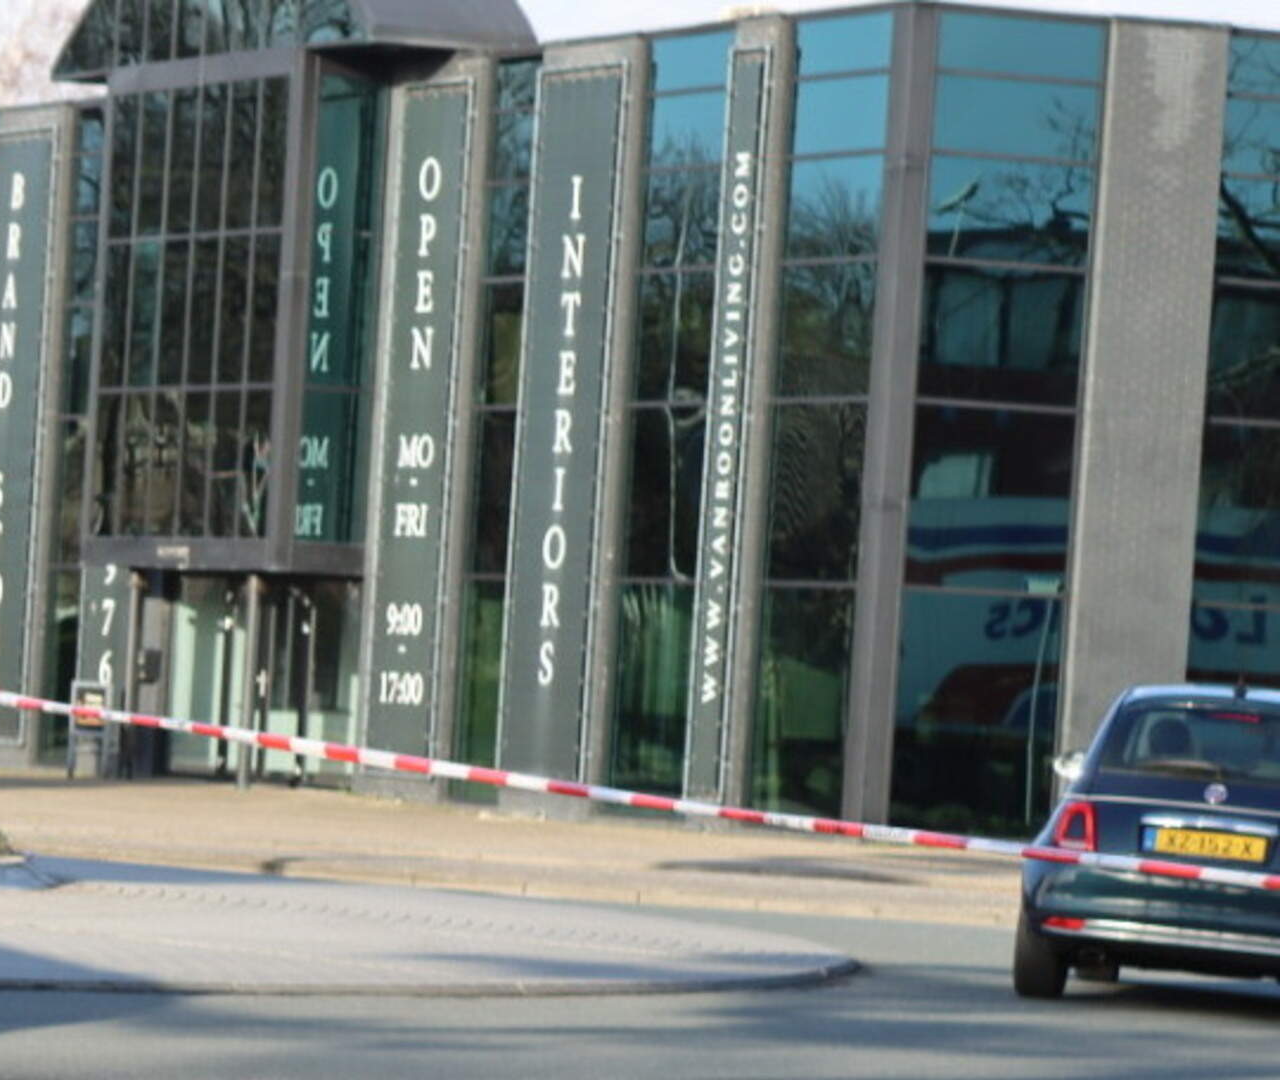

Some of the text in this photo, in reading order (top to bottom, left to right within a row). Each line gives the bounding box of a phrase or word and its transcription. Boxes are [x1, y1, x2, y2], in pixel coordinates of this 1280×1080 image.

[409, 156, 442, 370] OPEN
[538, 175, 585, 686] INTERIORS
[701, 151, 751, 704] WWW.VANROONLIVING.COM
[397, 434, 434, 468] MO
[394, 503, 428, 537] FRI
[386, 603, 423, 635] 9:00
[379, 671, 424, 706] 17:00
